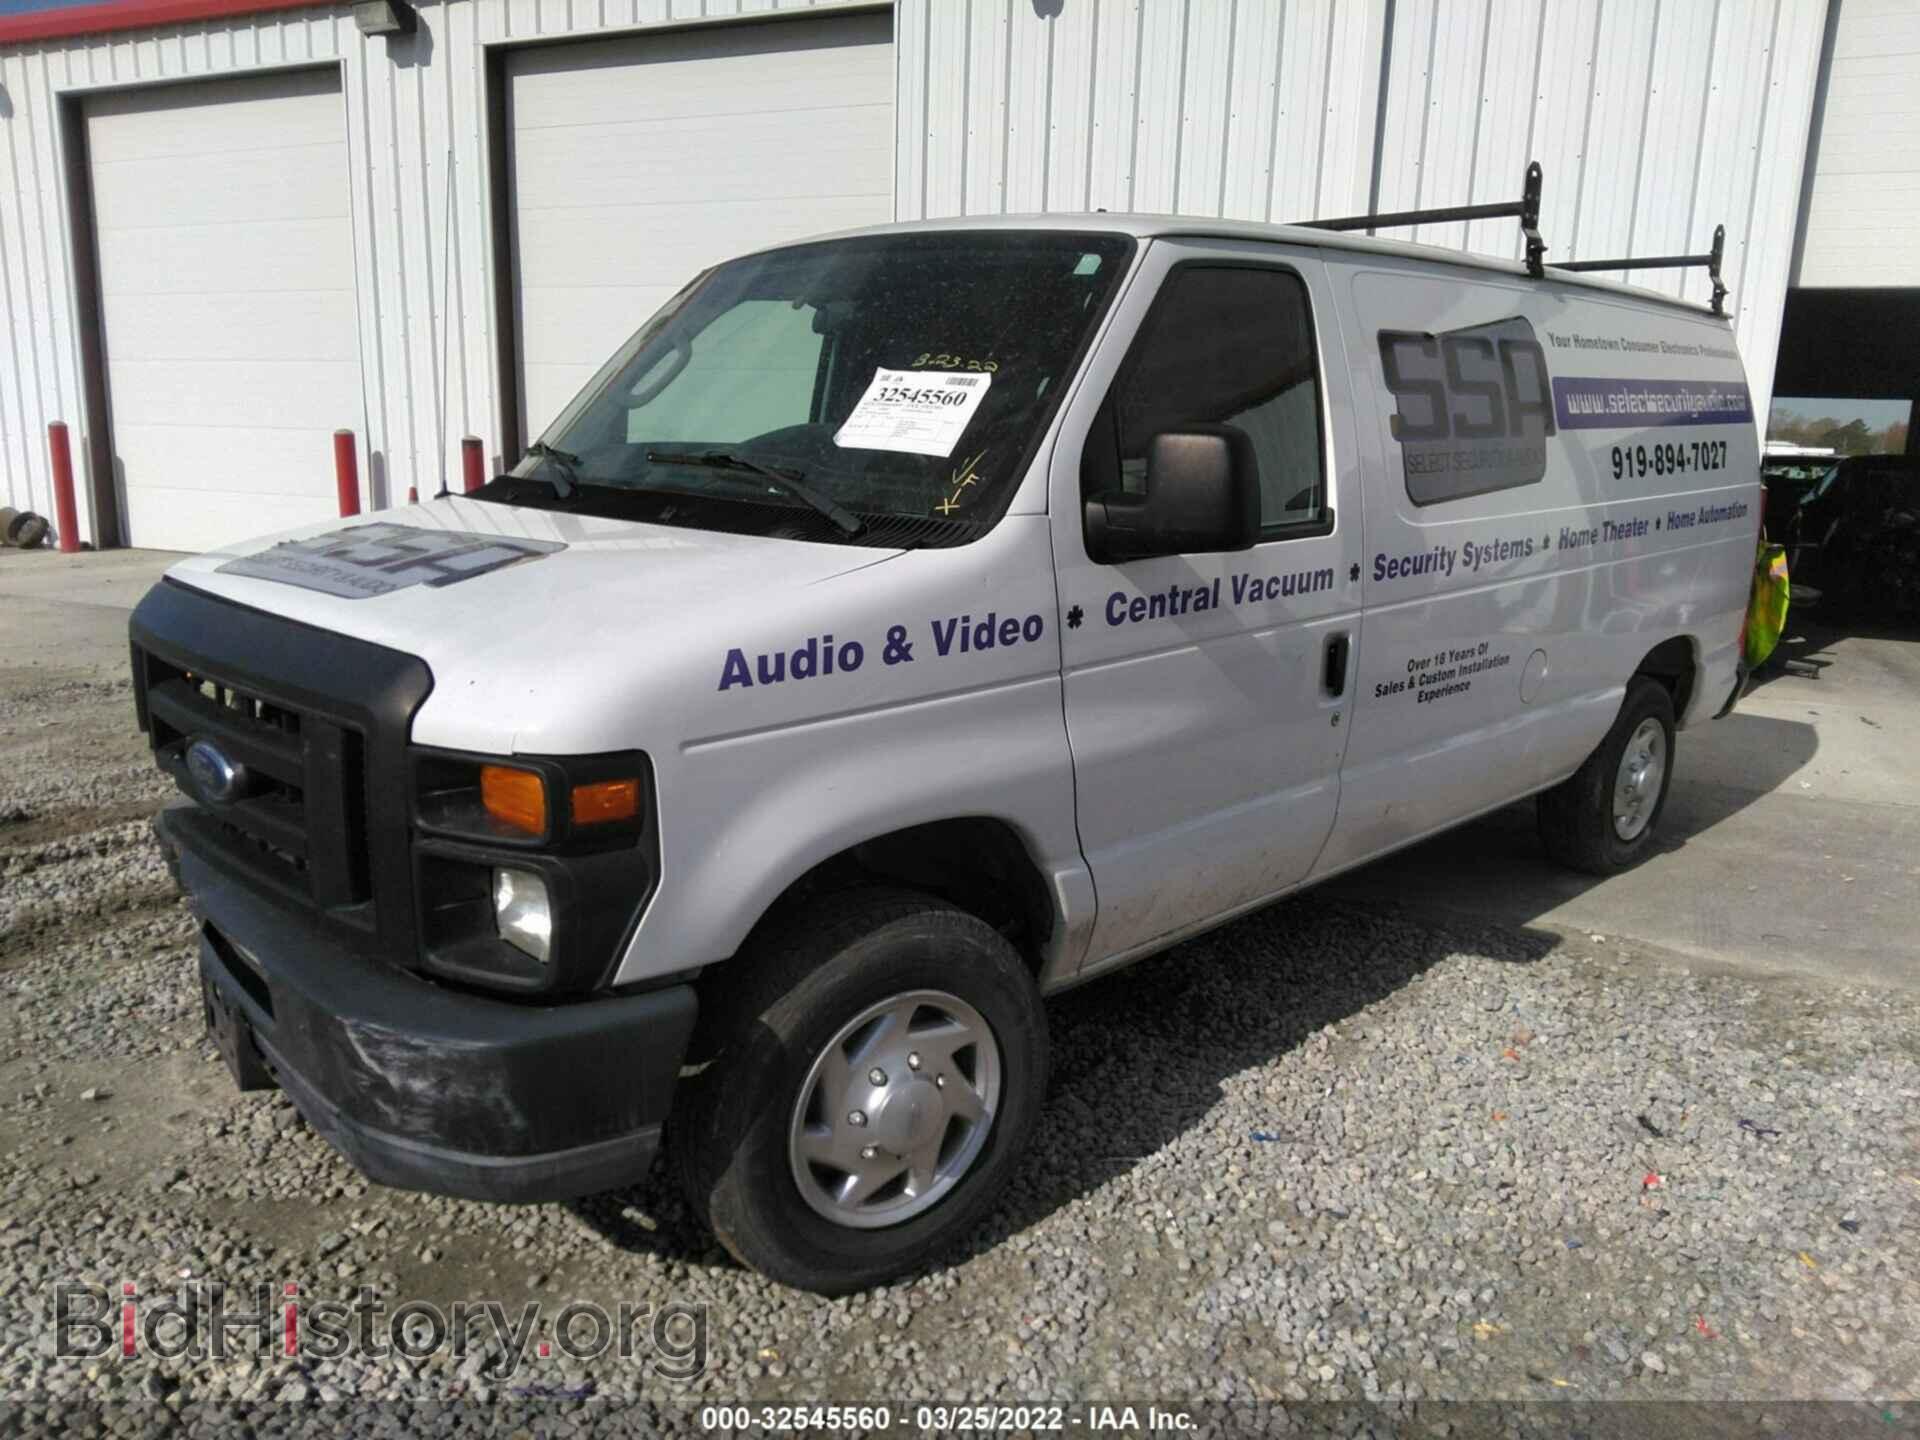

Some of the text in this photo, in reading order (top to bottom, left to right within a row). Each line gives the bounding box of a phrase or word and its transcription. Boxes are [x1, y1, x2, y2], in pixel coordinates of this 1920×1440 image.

[1547, 332, 1571, 348] Your
[1573, 334, 1619, 350] Hometown
[873, 387, 968, 407] 32545560
[1377, 329, 1556, 442] SSA
[1611, 440, 1727, 480] 919-894-7027
[717, 501, 1748, 691] Audio & Video Central Vacuum Security Systems Home Theater Home Automation
[1375, 655, 1510, 698] Sales & Custom Installation
[1407, 658, 1431, 673] Over
[1449, 647, 1475, 663] Years
[1417, 680, 1471, 703] Experience
